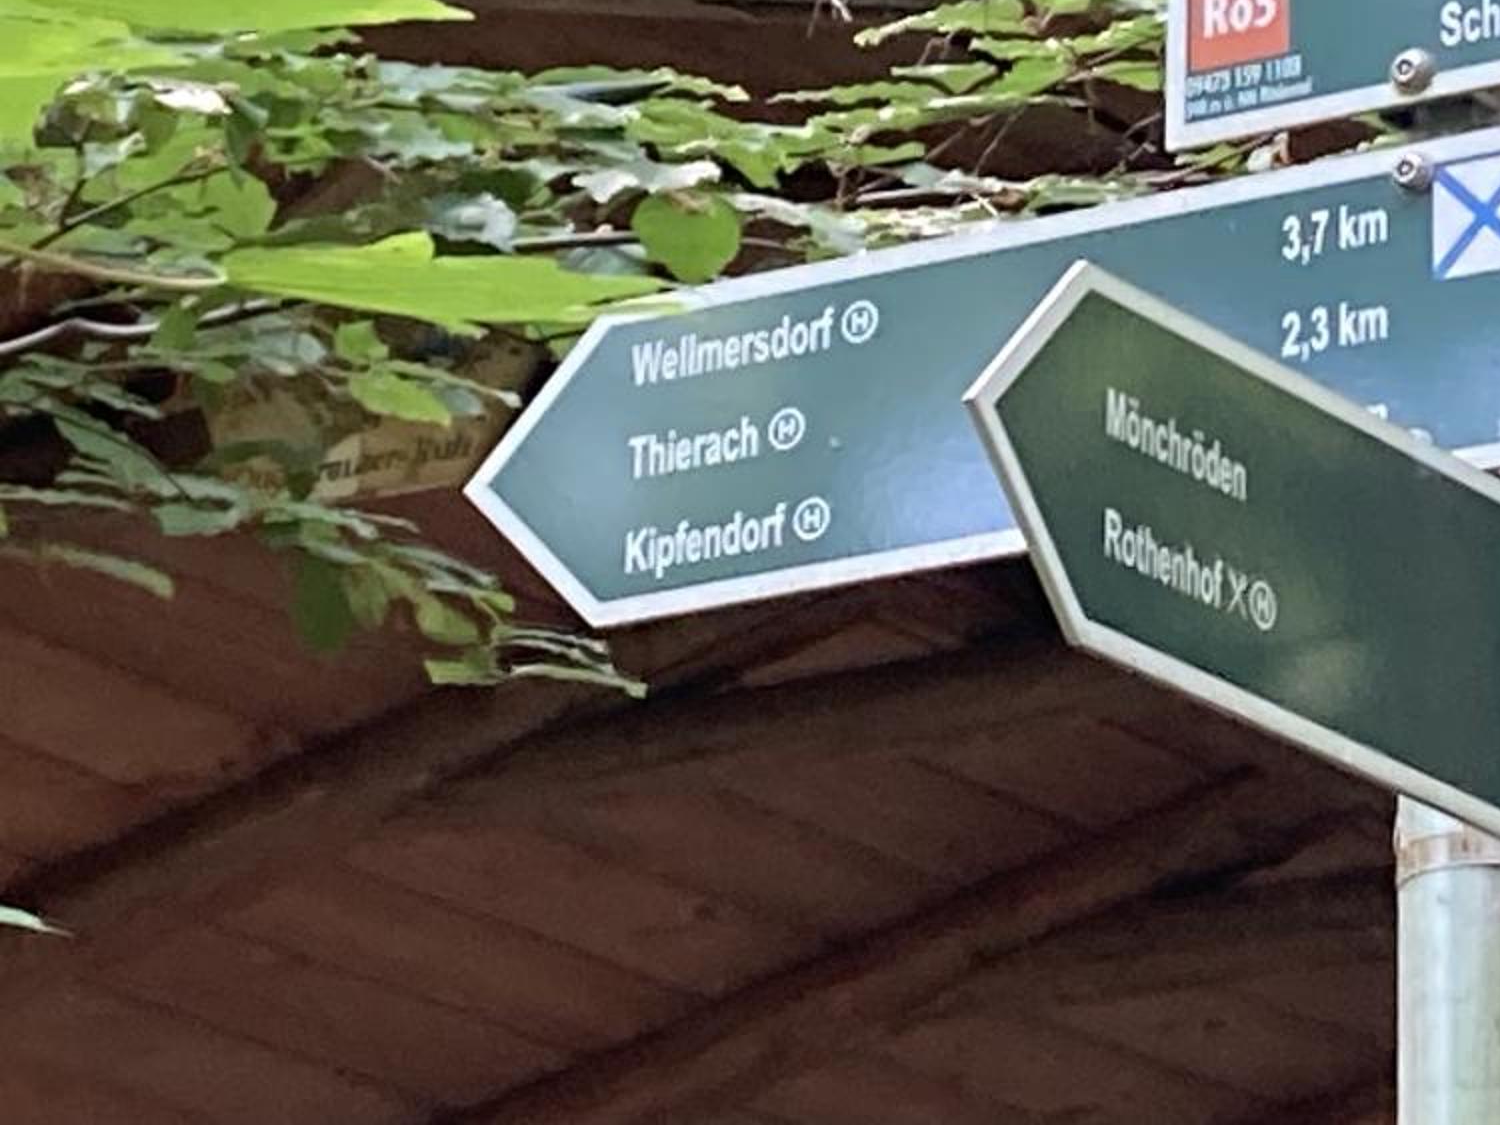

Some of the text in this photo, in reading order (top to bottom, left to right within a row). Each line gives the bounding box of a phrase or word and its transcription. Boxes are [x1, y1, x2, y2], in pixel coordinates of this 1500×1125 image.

[1281, 203, 1389, 266] 3,7 km
[630, 306, 836, 387] Wellmersdorf
[1280, 301, 1389, 362] 2,3 km
[626, 415, 759, 479] Thierach
[1105, 386, 1247, 502] Mönchröden
[623, 502, 788, 579] Kipfendorf
[1103, 506, 1224, 609] Rothenhof
